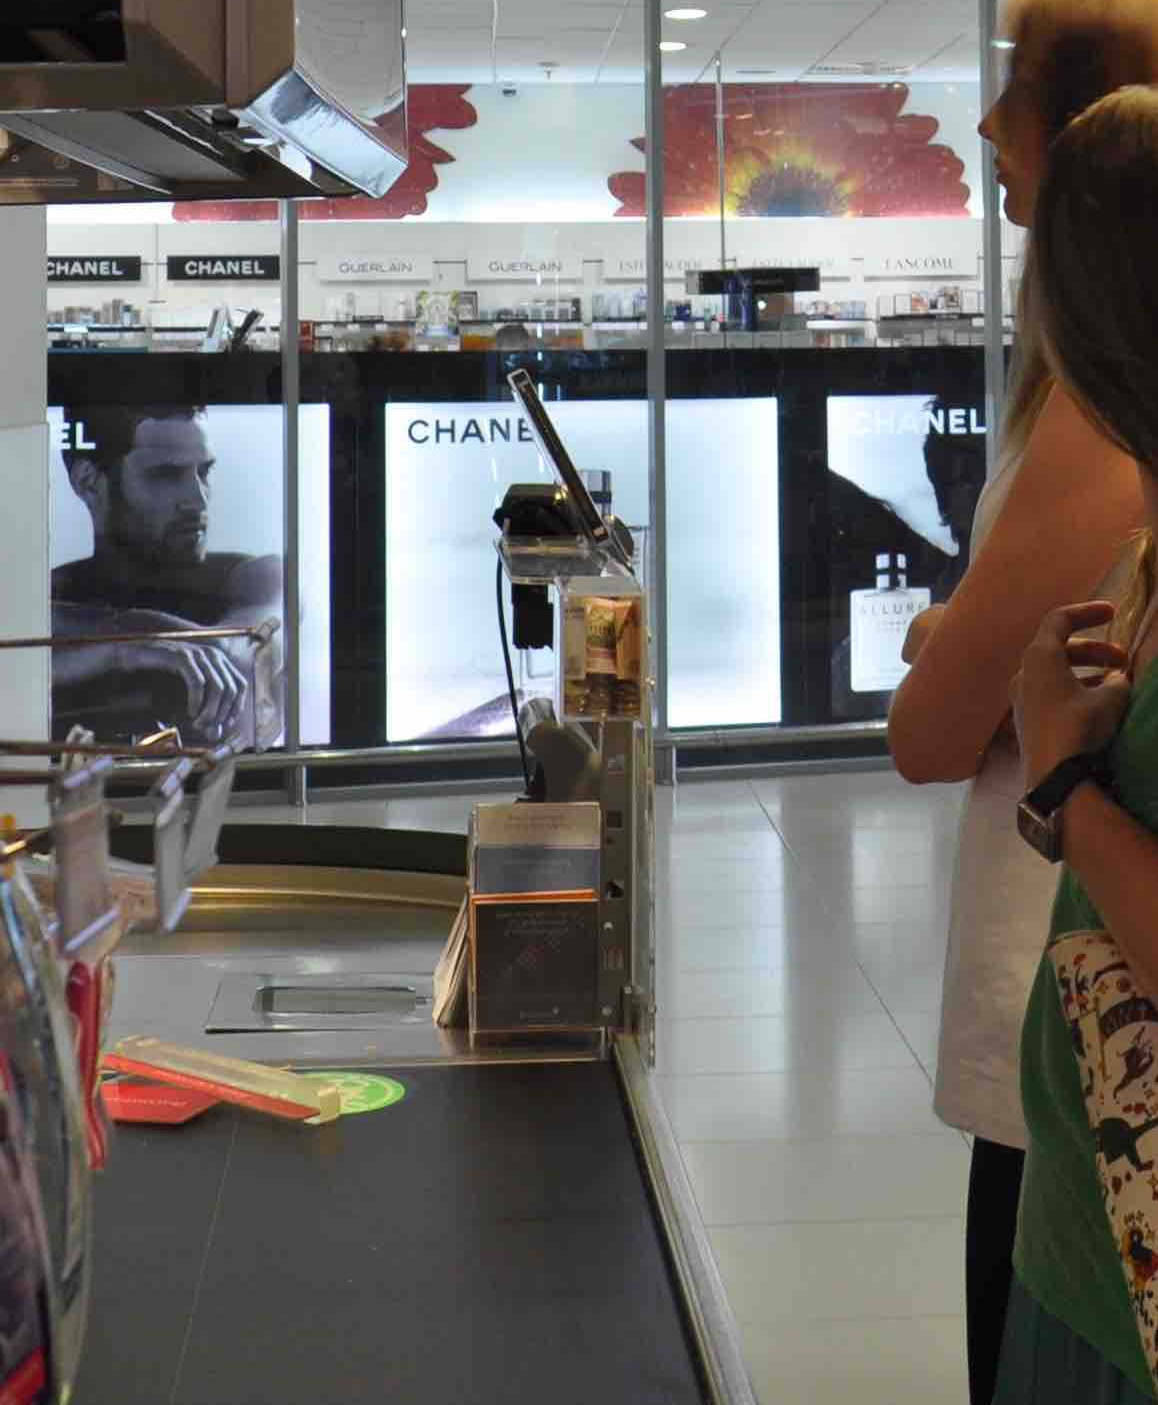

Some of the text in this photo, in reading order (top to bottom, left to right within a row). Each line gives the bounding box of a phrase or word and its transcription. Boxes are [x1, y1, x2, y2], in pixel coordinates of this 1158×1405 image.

[184, 260, 266, 276] CHANEL
[337, 261, 414, 275] GUERLAIN
[487, 260, 563, 274] GUERLAIN
[407, 417, 535, 445] CHANE
